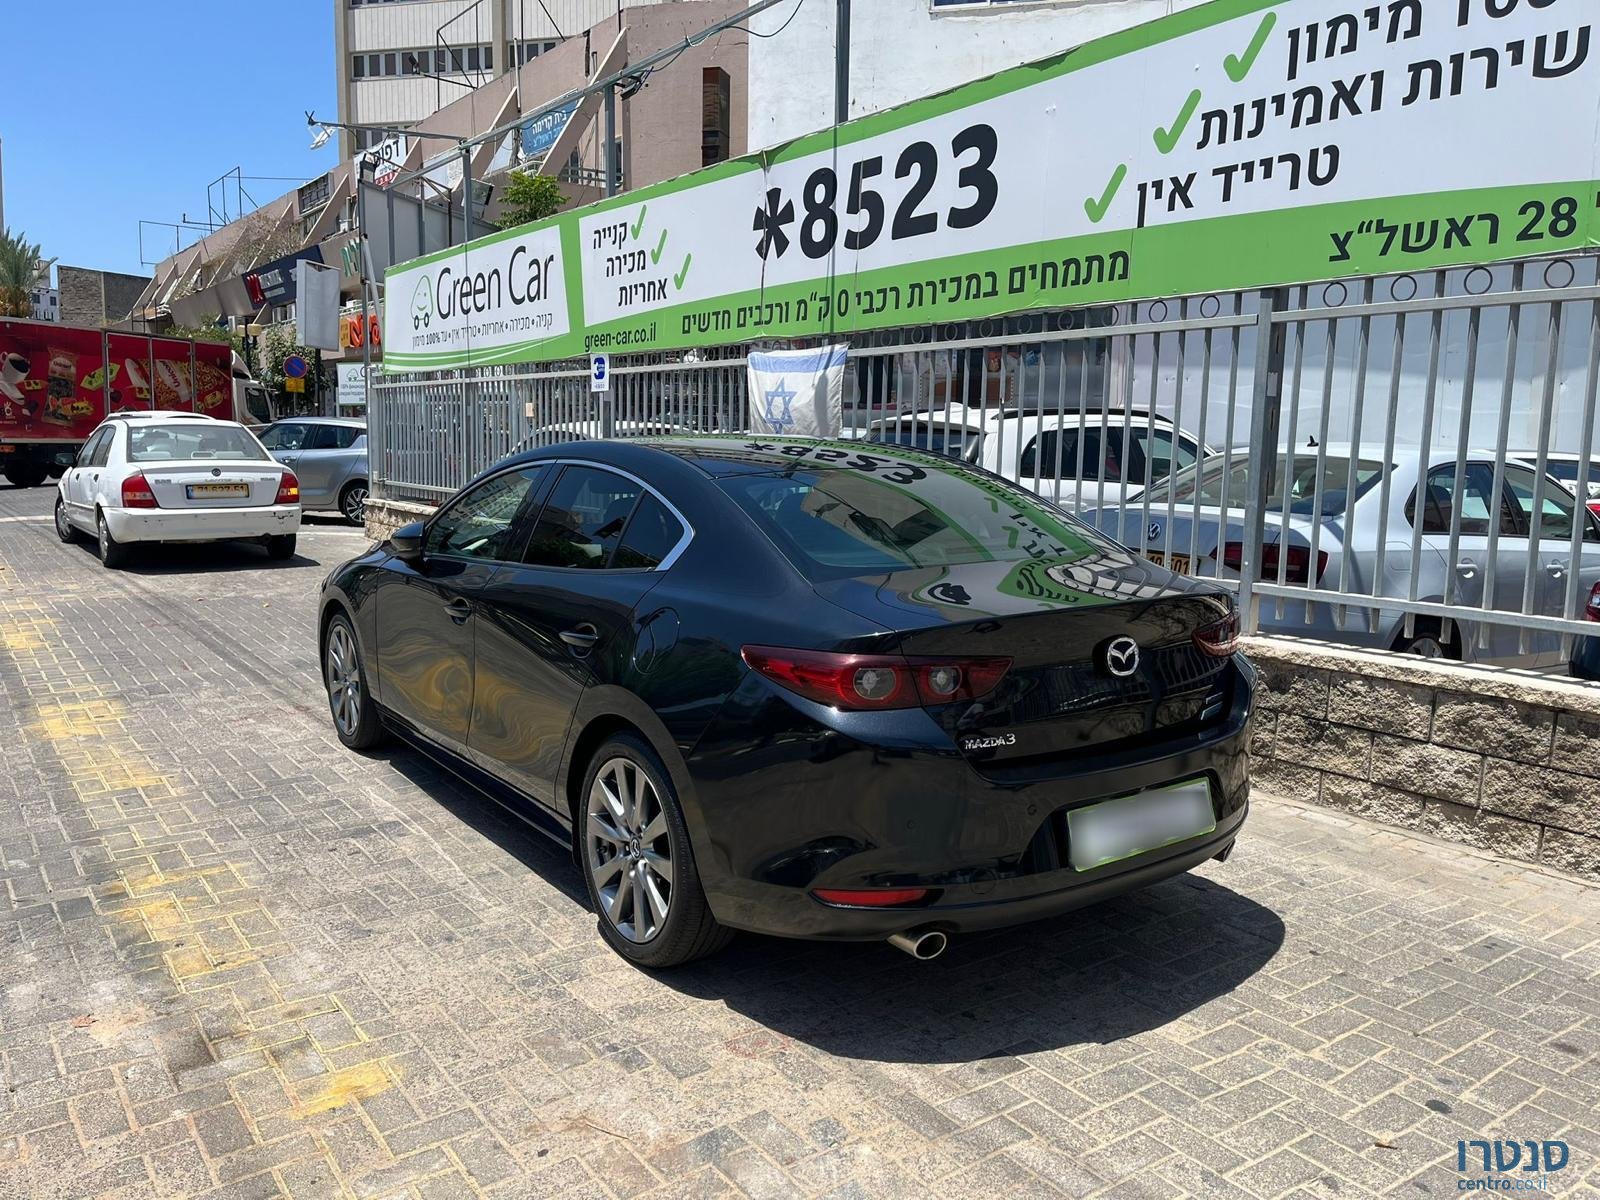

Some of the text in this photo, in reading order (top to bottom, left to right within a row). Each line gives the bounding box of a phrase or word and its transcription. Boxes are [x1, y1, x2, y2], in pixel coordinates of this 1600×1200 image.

[1287, 0, 1422, 81] מימון
[1197, 25, 1591, 150] שירות ואמינות
[1137, 144, 1340, 229] טרייד אין
[1516, 197, 1578, 241] 28
[593, 222, 627, 250] קנייה
[606, 249, 646, 277] מכירה
[1008, 250, 1129, 295] מתמחים
[437, 245, 554, 320] Green Car
[618, 278, 667, 307] אחריות
[907, 271, 998, 308] במכירת
[737, 301, 789, 329] ורכבים
[856, 286, 900, 315] רכבי
[584, 322, 656, 352] green-car.co.il
[682, 309, 731, 334] חדשים
